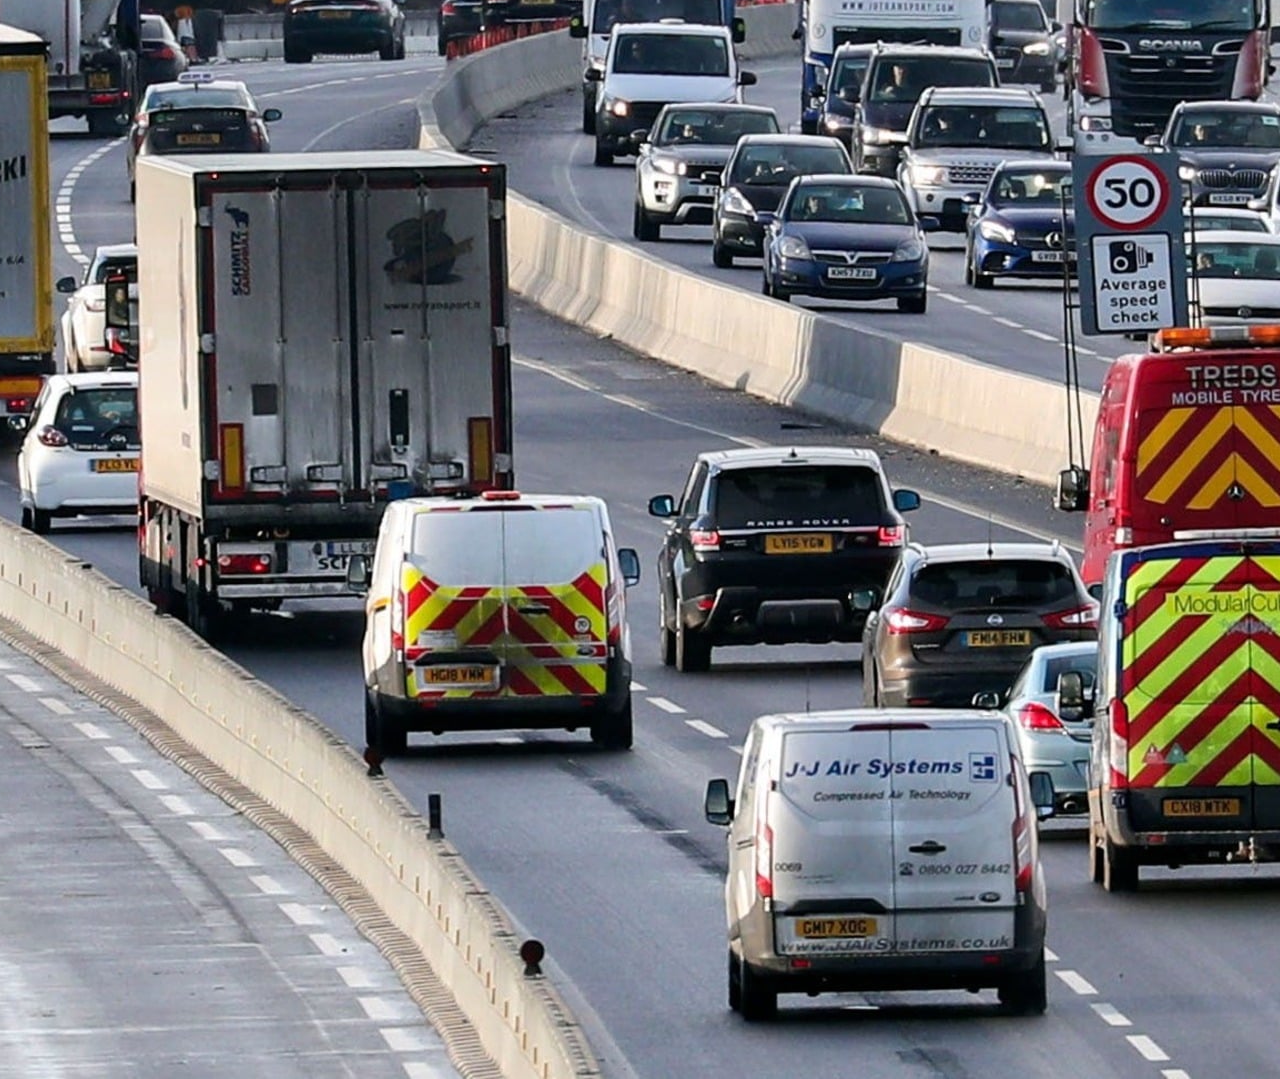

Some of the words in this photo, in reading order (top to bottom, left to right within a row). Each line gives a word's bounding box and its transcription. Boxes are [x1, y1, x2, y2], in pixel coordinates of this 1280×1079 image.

[1138, 39, 1204, 51] SCANIA
[1103, 177, 1155, 209] 50
[230, 227, 241, 296] SCHMITZ
[1100, 278, 1167, 292] Average
[1110, 294, 1158, 308] speed
[1111, 310, 1159, 324] check
[1185, 364, 1278, 389] TREDS
[1172, 390, 1232, 405] MOBILE
[747, 519, 794, 527] RANGE
[802, 517, 850, 526] ROVER
[826, 758, 861, 776] Air
[866, 758, 964, 778] Systems
[813, 791, 884, 803] Compressed
[889, 791, 904, 801] Air
[908, 789, 972, 802] Technology
[919, 864, 951, 874] 0800
[955, 864, 978, 874] 027
[780, 936, 1010, 954] www.JJAirSystems.co.uk
